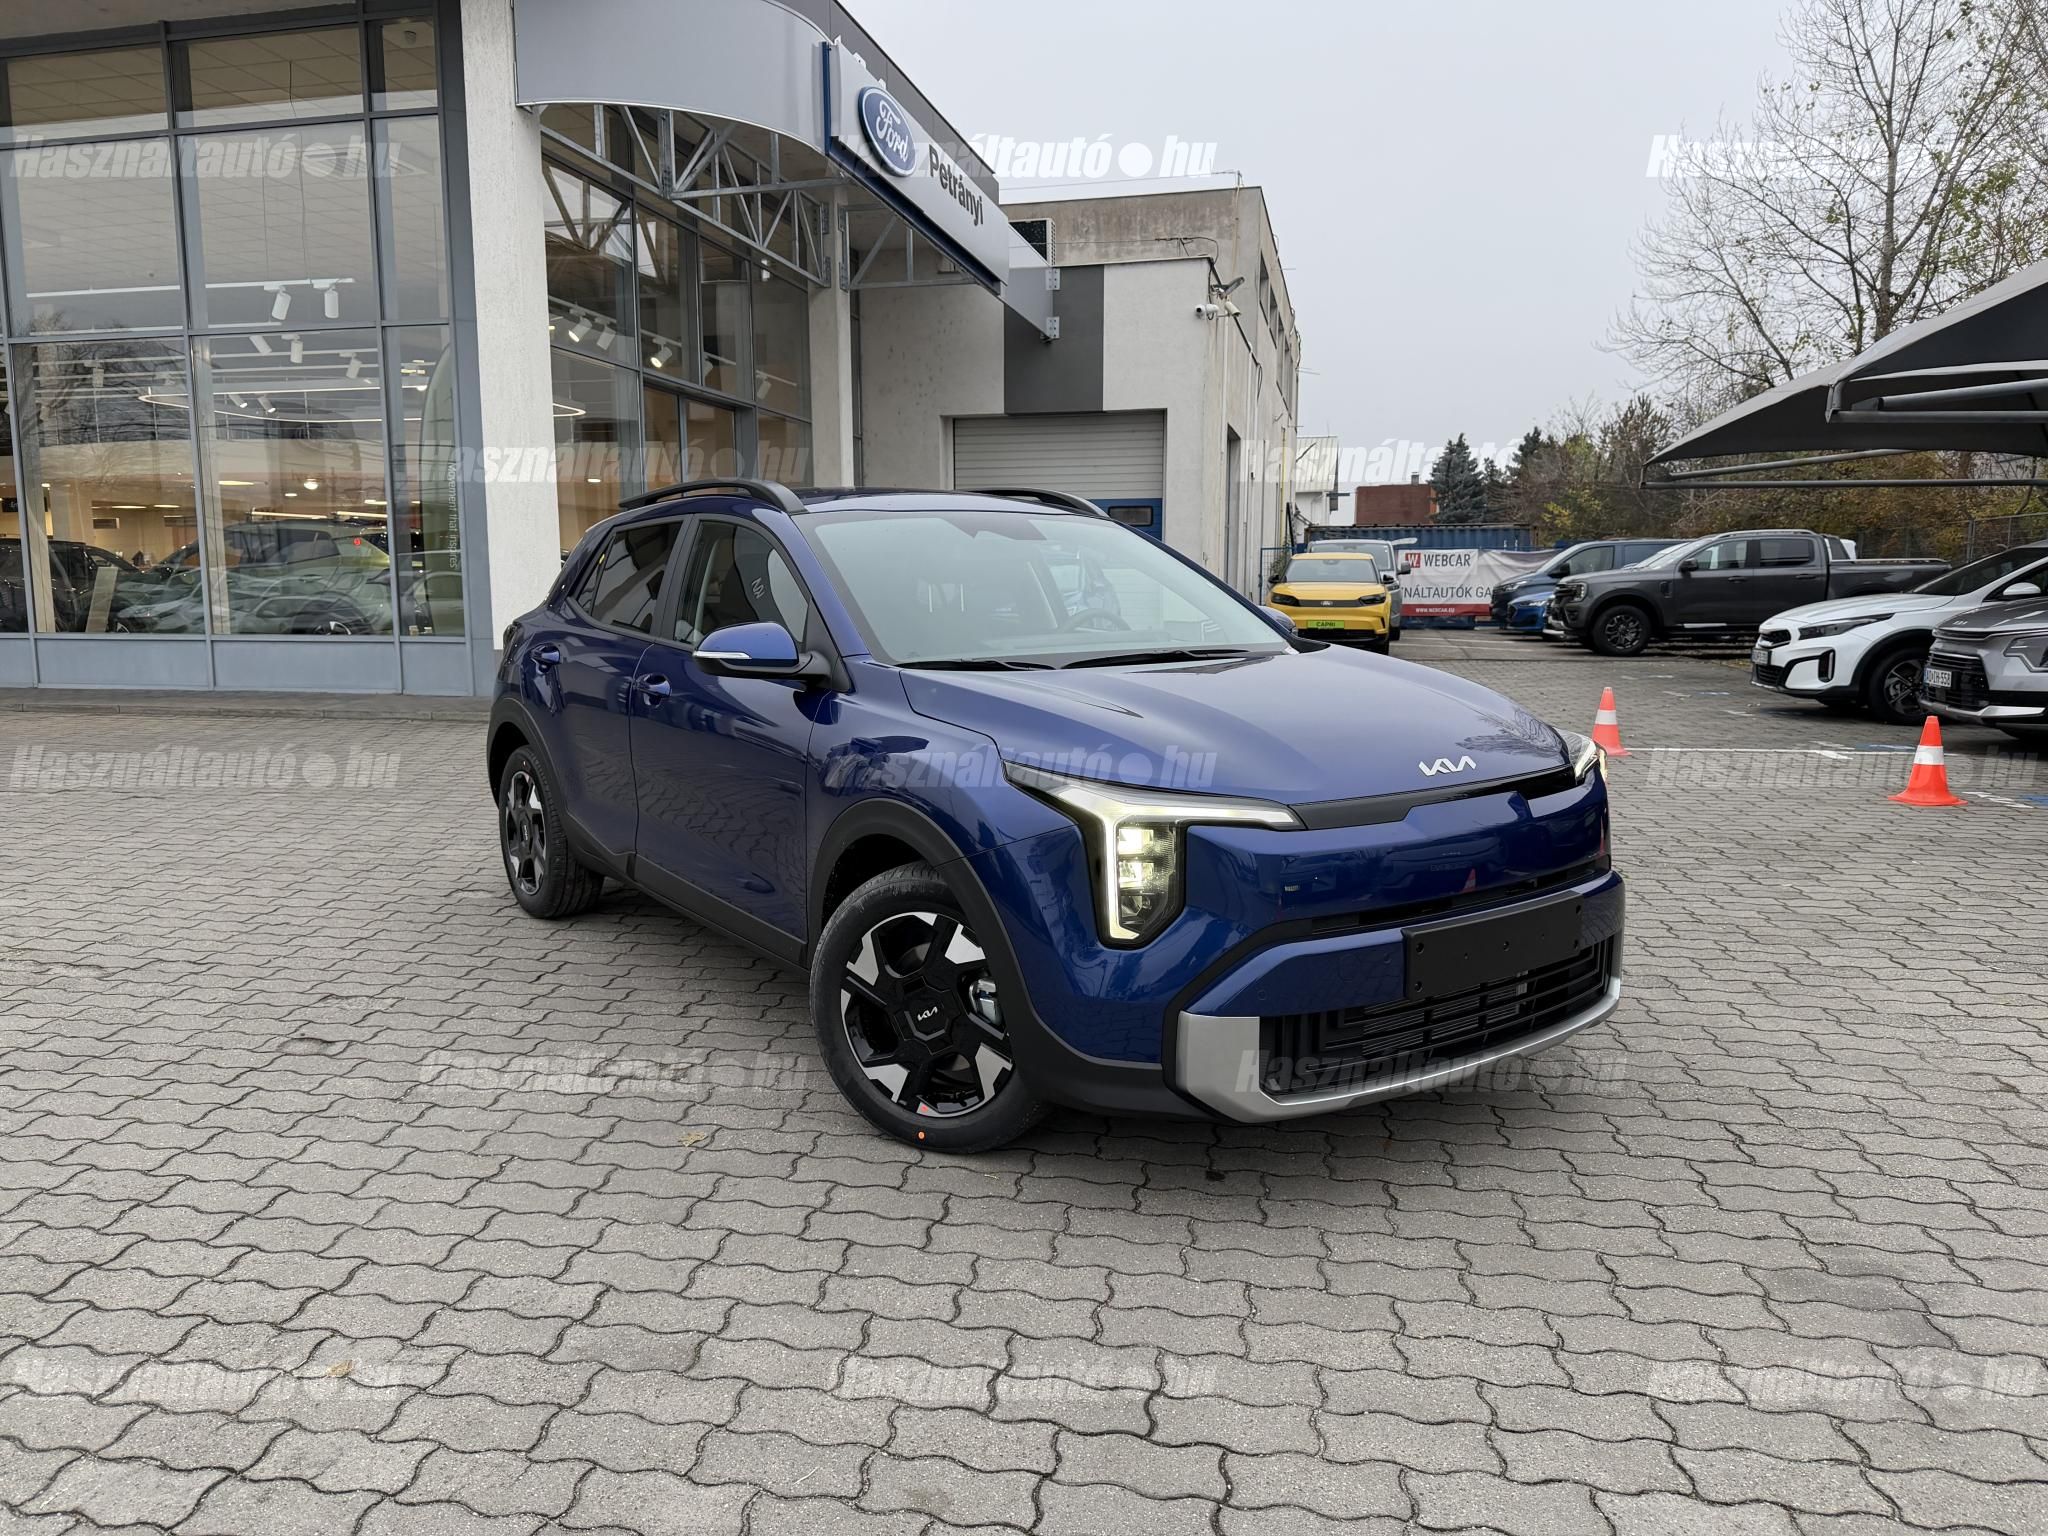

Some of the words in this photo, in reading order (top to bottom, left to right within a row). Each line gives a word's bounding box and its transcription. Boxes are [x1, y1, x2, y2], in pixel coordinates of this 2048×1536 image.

[876, 100, 908, 162] Ford
[929, 143, 984, 227] Petrányi
[1424, 553, 1471, 567] WEBCAR
[1401, 584, 1472, 599] NÁLTAUTÓK
[1418, 755, 1477, 777] KIA
